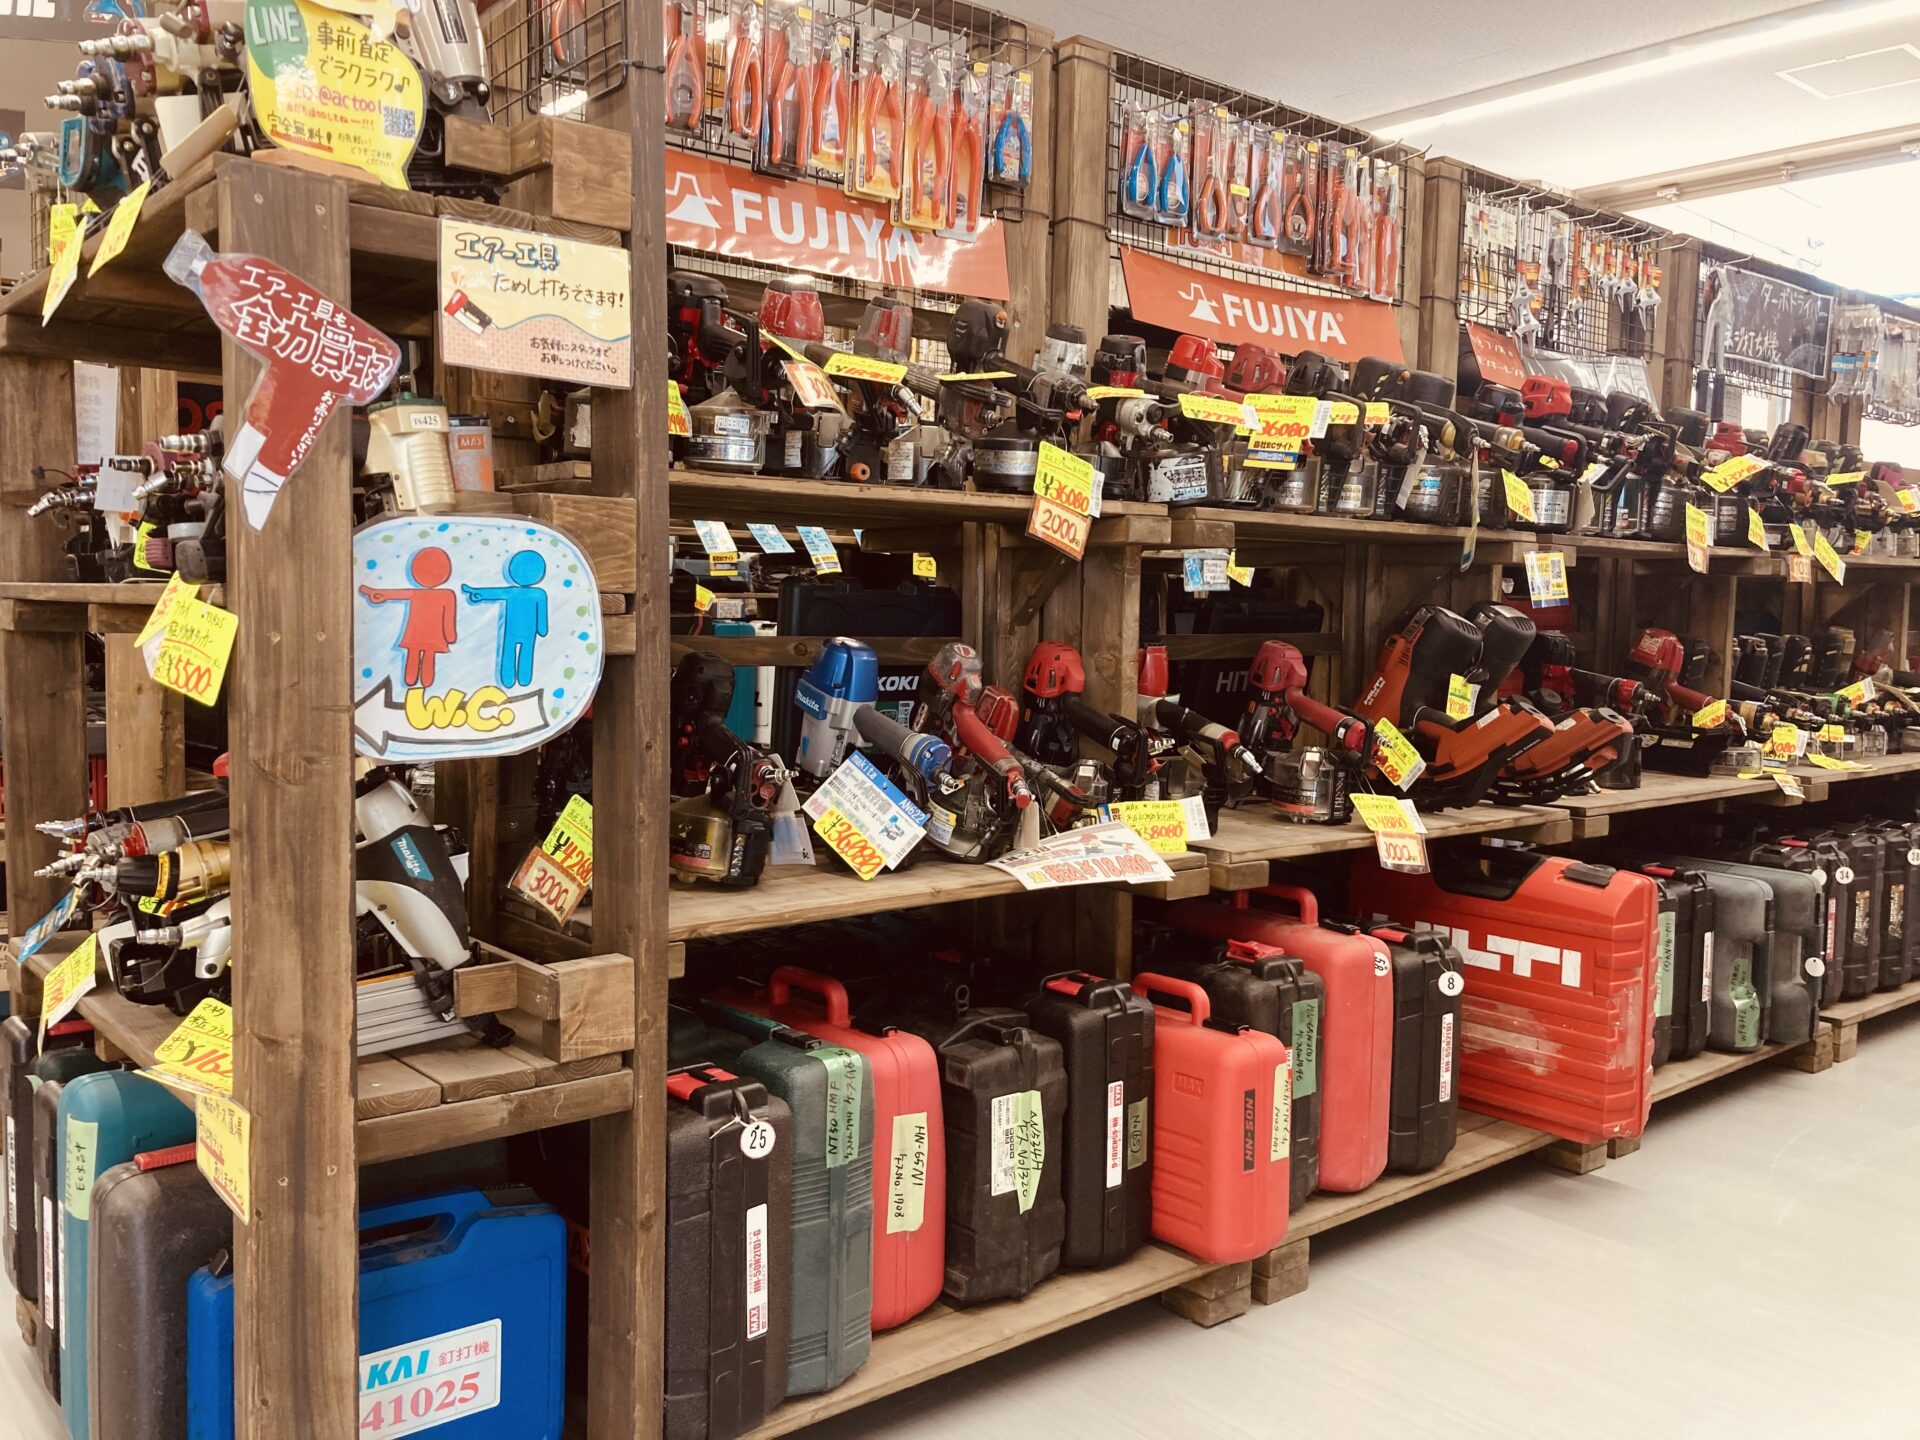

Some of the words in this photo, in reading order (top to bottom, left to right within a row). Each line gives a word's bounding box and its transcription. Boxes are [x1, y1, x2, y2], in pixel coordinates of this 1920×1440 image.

[250, 5, 301, 46] LINE
[731, 187, 922, 264] FUJIYA
[454, 231, 560, 272] エアー工具
[493, 271, 625, 309] ためし打ちできます!
[1222, 293, 1347, 345] FUJIYA
[230, 293, 394, 391] 全力買取
[412, 413, 440, 428] TS425
[1253, 440, 1294, 450] 自社ECサイト
[877, 675, 920, 692] KOKI
[405, 685, 515, 733] W.C.
[853, 754, 877, 780] makita
[899, 798, 926, 824] AN622
[396, 836, 422, 877] makita
[1839, 871, 1850, 880] 34
[1447, 977, 1455, 990] 8
[1113, 1084, 1122, 1106] MAX
[749, 1129, 767, 1149] 25
[1245, 1096, 1254, 1162] HN-50N
[748, 1305, 761, 1336] MAX
[359, 1349, 431, 1392] KAI
[438, 1339, 490, 1368] 釘打機
[359, 1370, 481, 1432] 41025
